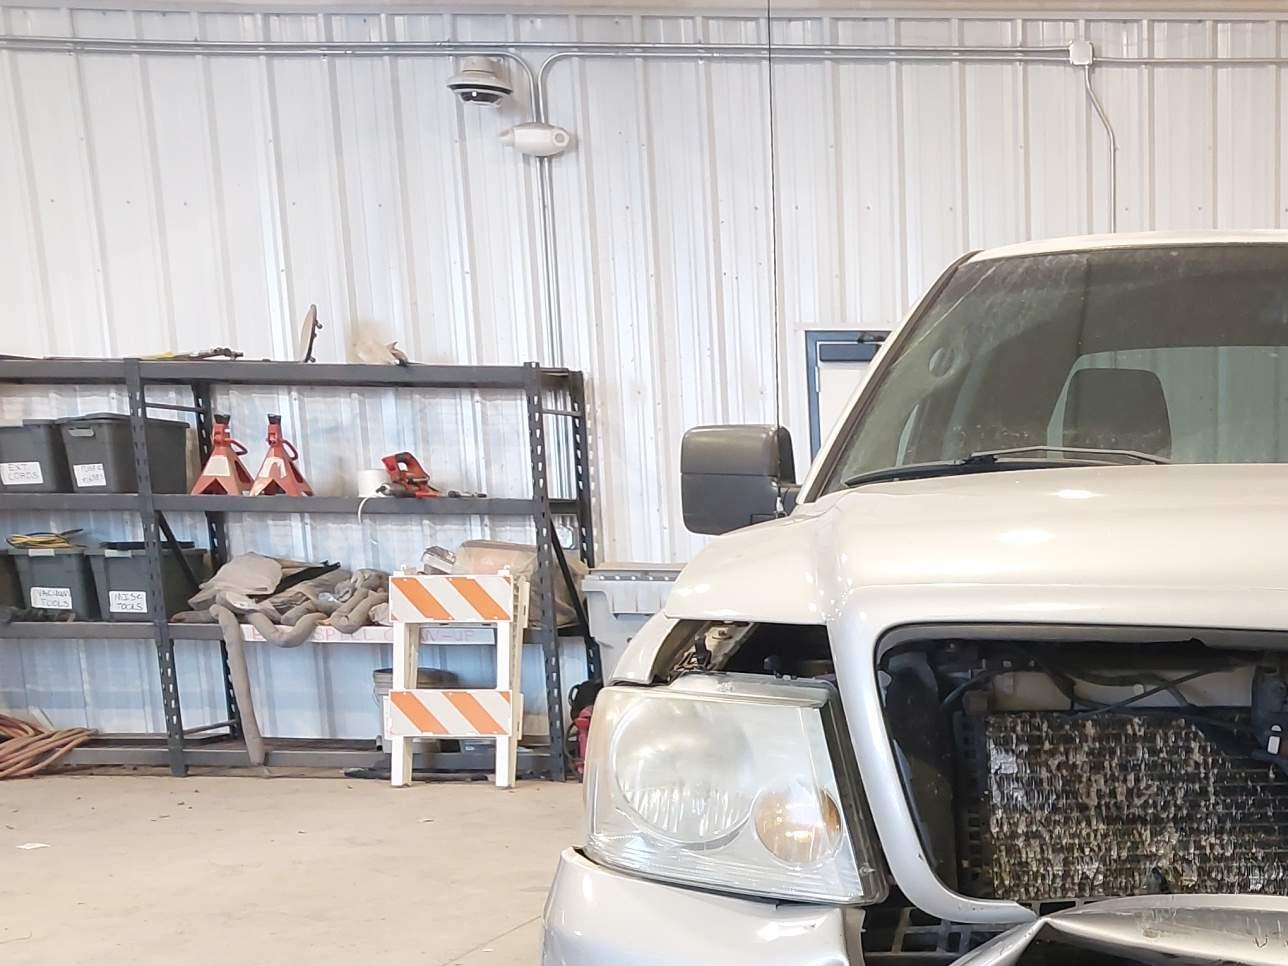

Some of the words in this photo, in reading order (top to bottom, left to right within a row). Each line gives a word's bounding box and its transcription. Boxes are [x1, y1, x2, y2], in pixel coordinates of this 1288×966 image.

[8, 471, 39, 480] CORDS
[114, 592, 143, 601] MISC
[40, 598, 70, 608] TOOLS
[116, 602, 143, 611] TOOLS
